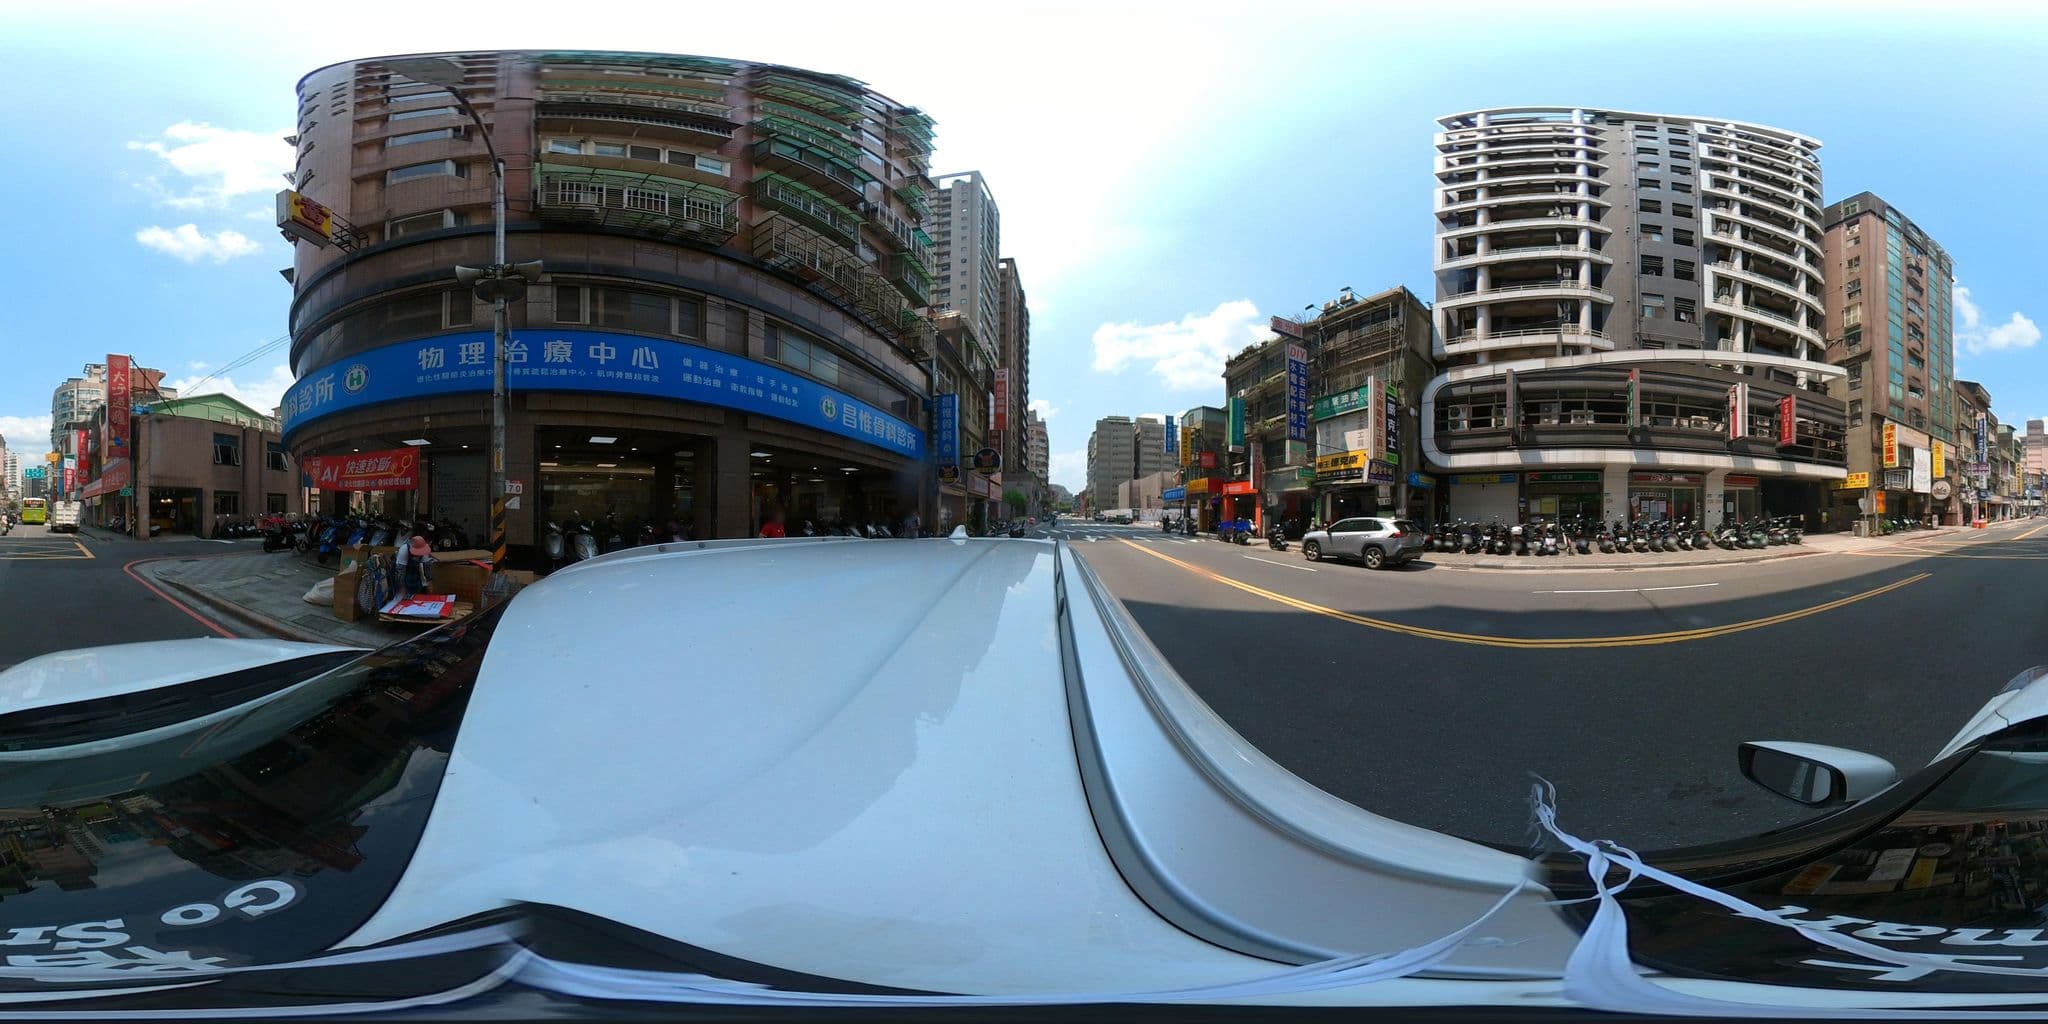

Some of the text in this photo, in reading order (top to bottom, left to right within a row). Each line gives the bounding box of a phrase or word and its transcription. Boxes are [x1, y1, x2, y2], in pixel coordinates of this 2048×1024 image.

[418, 339, 660, 370] 物理治療中心
[1290, 347, 1306, 358] DIY
[842, 402, 916, 451] 昌惟骨科診所
[321, 465, 338, 482] AI
[345, 456, 391, 474] 快速診斷
[161, 879, 297, 926] Go
